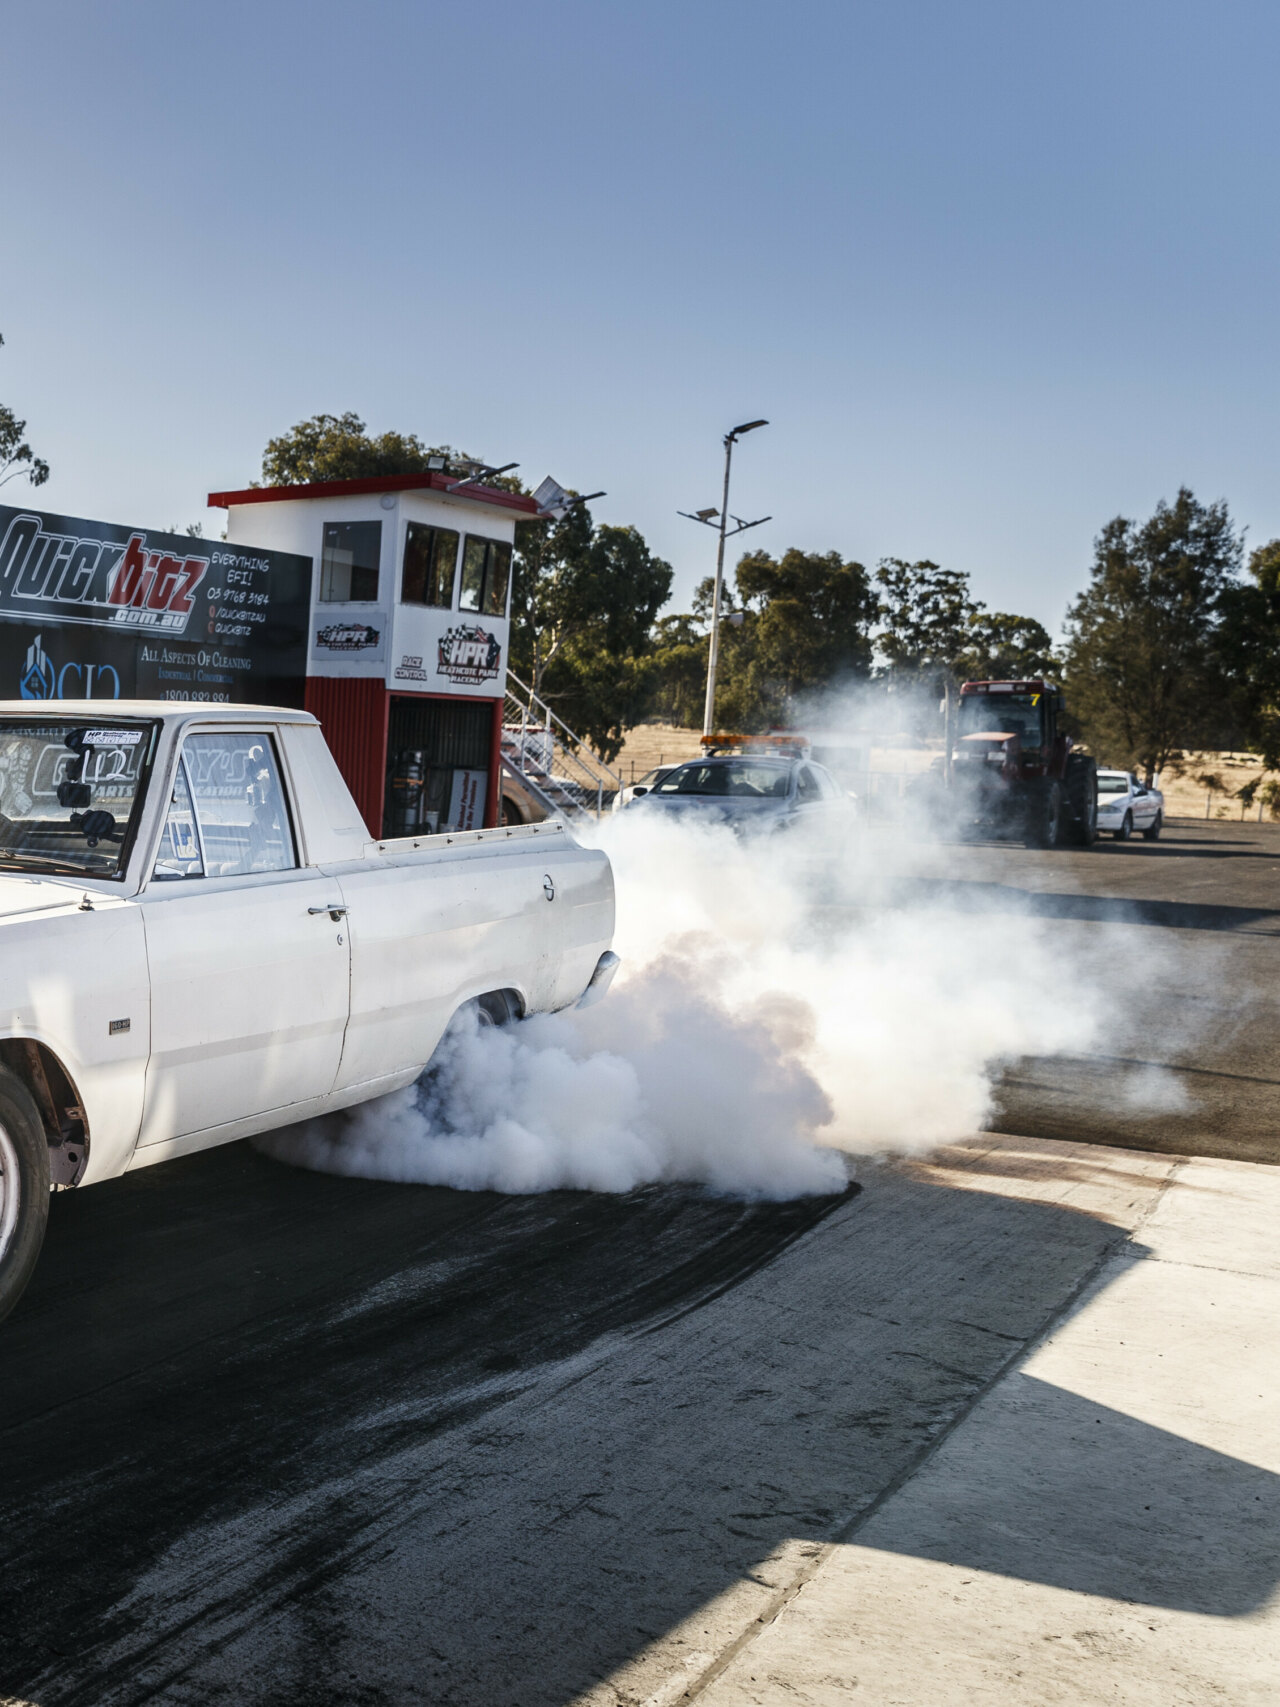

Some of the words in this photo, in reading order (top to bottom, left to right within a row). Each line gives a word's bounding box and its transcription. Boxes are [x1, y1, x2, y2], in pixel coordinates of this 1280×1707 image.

[211, 552, 269, 572] EVERYTHING
[227, 569, 252, 586] EFI!
[207, 587, 221, 599] 03
[223, 589, 246, 603] 9768
[247, 592, 269, 605] 3184
[108, 609, 185, 629] .com.au
[329, 631, 368, 641] HPR
[449, 640, 490, 666] HPR
[402, 656, 422, 667] RACE
[395, 668, 427, 681] CONTROL
[438, 664, 477, 676] HEATHCOTE
[478, 668, 498, 678] PARK
[1030, 694, 1041, 706] 7
